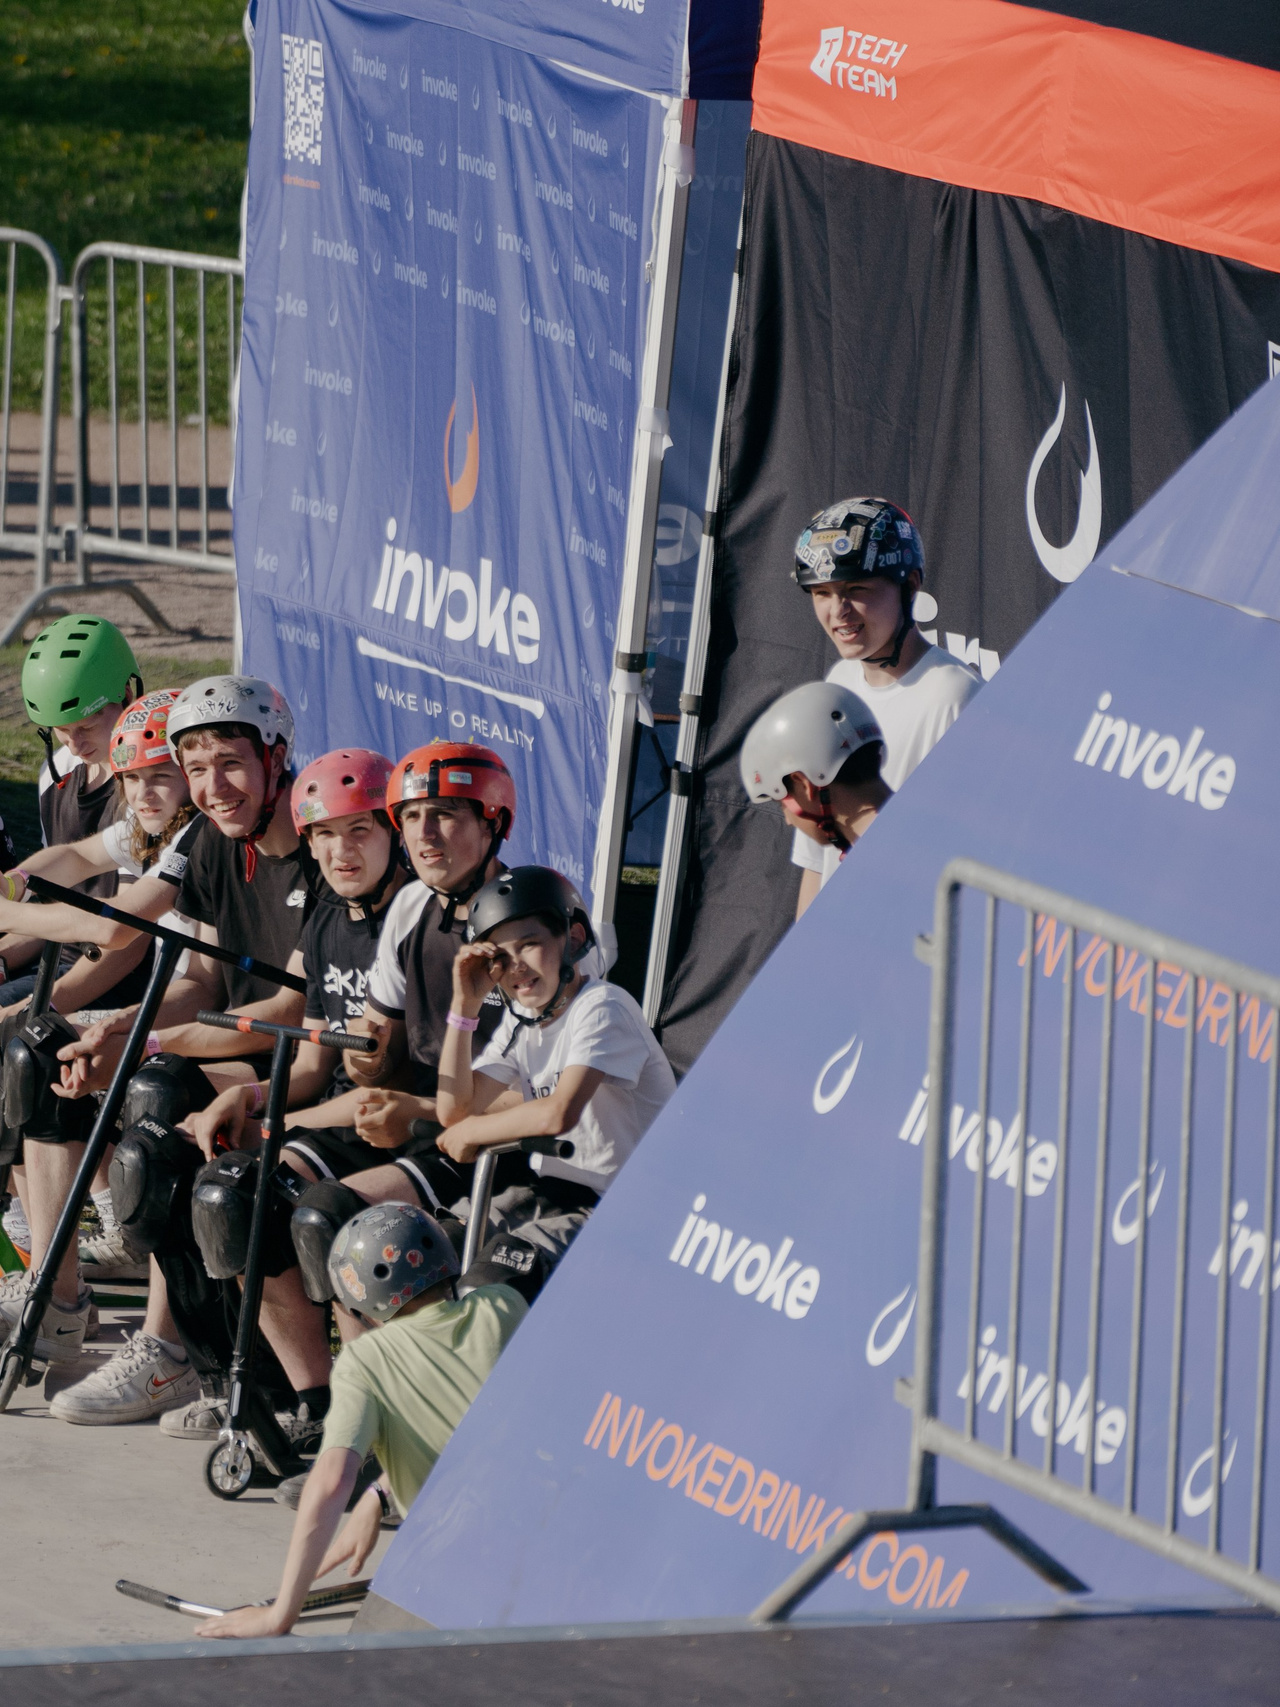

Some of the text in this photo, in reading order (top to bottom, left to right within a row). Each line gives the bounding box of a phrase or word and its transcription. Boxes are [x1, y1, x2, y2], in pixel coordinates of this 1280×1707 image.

[352, 47, 387, 82] invoke
[846, 29, 908, 69] TECH
[422, 68, 458, 102] invoke
[834, 60, 897, 101] TEAM
[496, 89, 533, 128] invoke
[386, 124, 424, 158] invoke
[572, 119, 608, 158] invoke
[457, 145, 497, 181] invoke
[358, 177, 391, 213] invoke
[534, 172, 574, 211] invoke
[312, 230, 359, 266] invoke
[394, 255, 428, 290] invoke
[573, 256, 610, 295] invoke
[456, 279, 497, 316] invoke
[533, 308, 575, 348] invoke
[304, 359, 353, 396] invoke
[574, 391, 608, 432] invoke
[290, 487, 339, 523] invoke
[569, 525, 607, 568] invoke
[371, 516, 541, 665] invoke
[374, 680, 419, 712] WAKE
[424, 696, 443, 719] UP
[471, 714, 535, 752] REALITY
[1073, 690, 1237, 811] invoke
[669, 1193, 821, 1320] invoke
